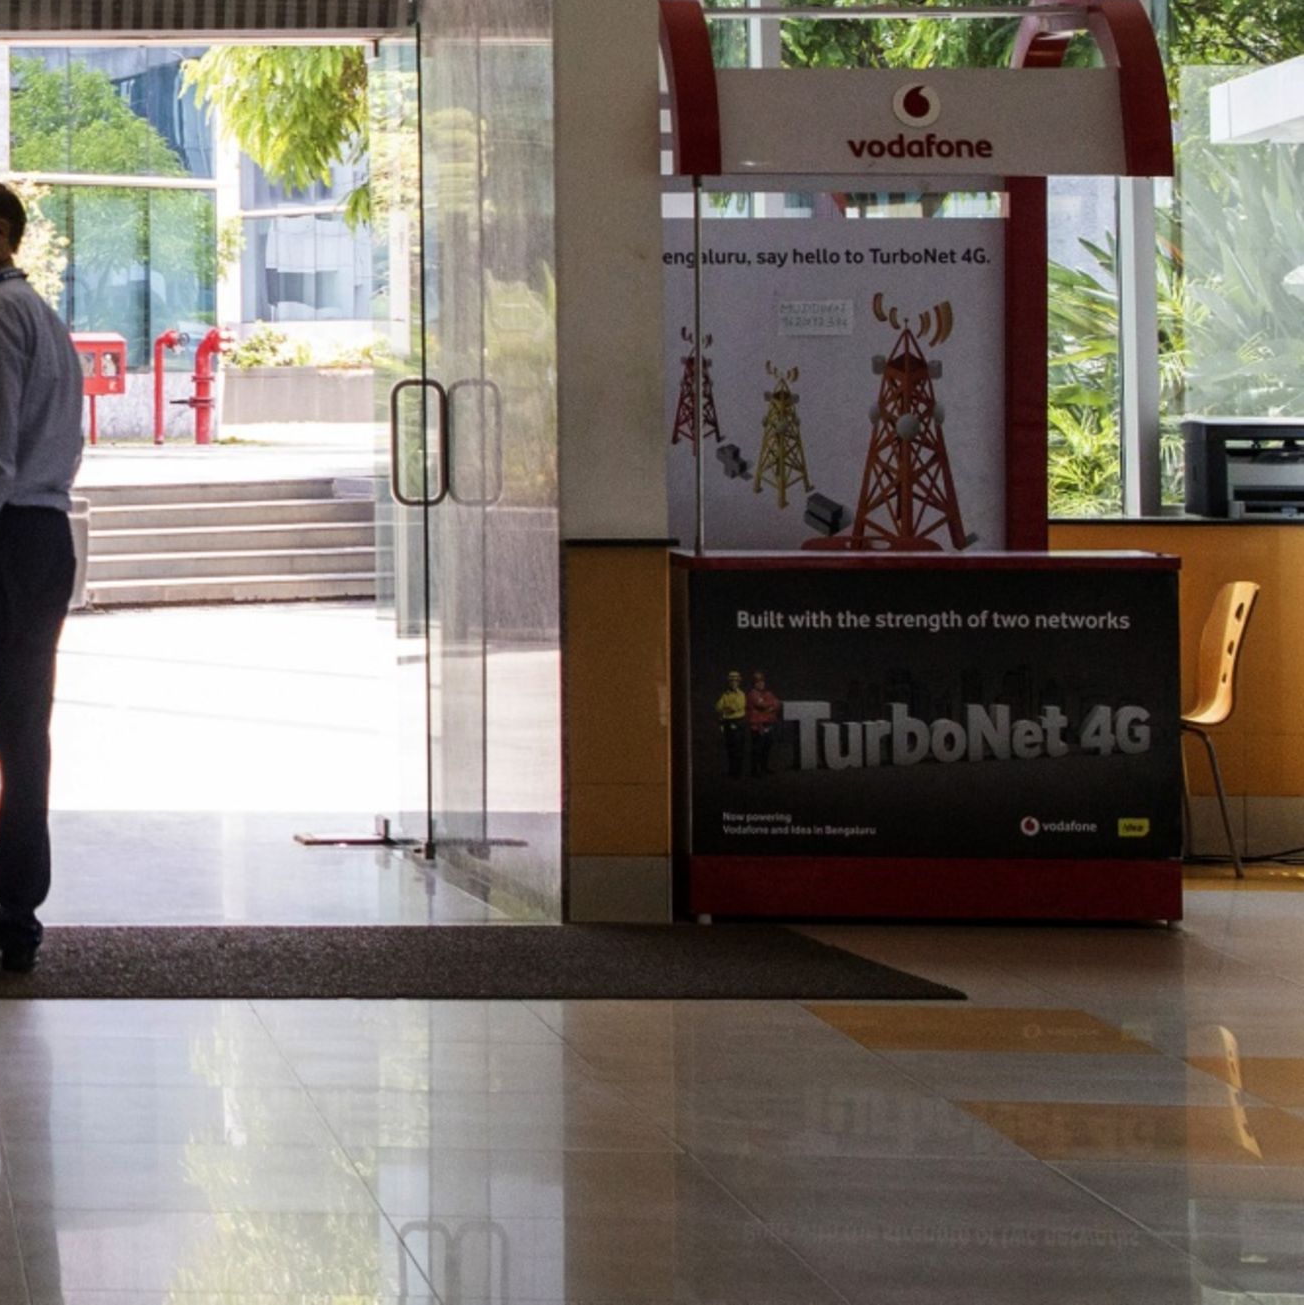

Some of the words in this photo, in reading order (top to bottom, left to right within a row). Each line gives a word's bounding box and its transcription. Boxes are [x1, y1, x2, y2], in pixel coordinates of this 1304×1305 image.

[847, 134, 993, 159] vodafone
[663, 249, 751, 269] engaluru,
[756, 252, 788, 269] say
[793, 248, 841, 265] hello
[845, 251, 864, 264] to
[869, 249, 956, 265] TurboNet
[962, 249, 991, 265] 4G.
[737, 611, 784, 629] Built
[789, 611, 832, 628] with
[837, 611, 871, 629] the
[875, 611, 962, 632] strength
[967, 610, 990, 629] of
[993, 613, 1030, 629] two
[1035, 612, 1130, 630] networks
[782, 700, 1069, 771] TurboNet
[1080, 704, 1152, 756] 4G
[723, 812, 744, 822] Now
[746, 812, 792, 824] powering
[1042, 820, 1097, 833] vodafone
[723, 825, 768, 835] Vodafone
[770, 825, 788, 835] and
[825, 825, 876, 837] Bengaluru
